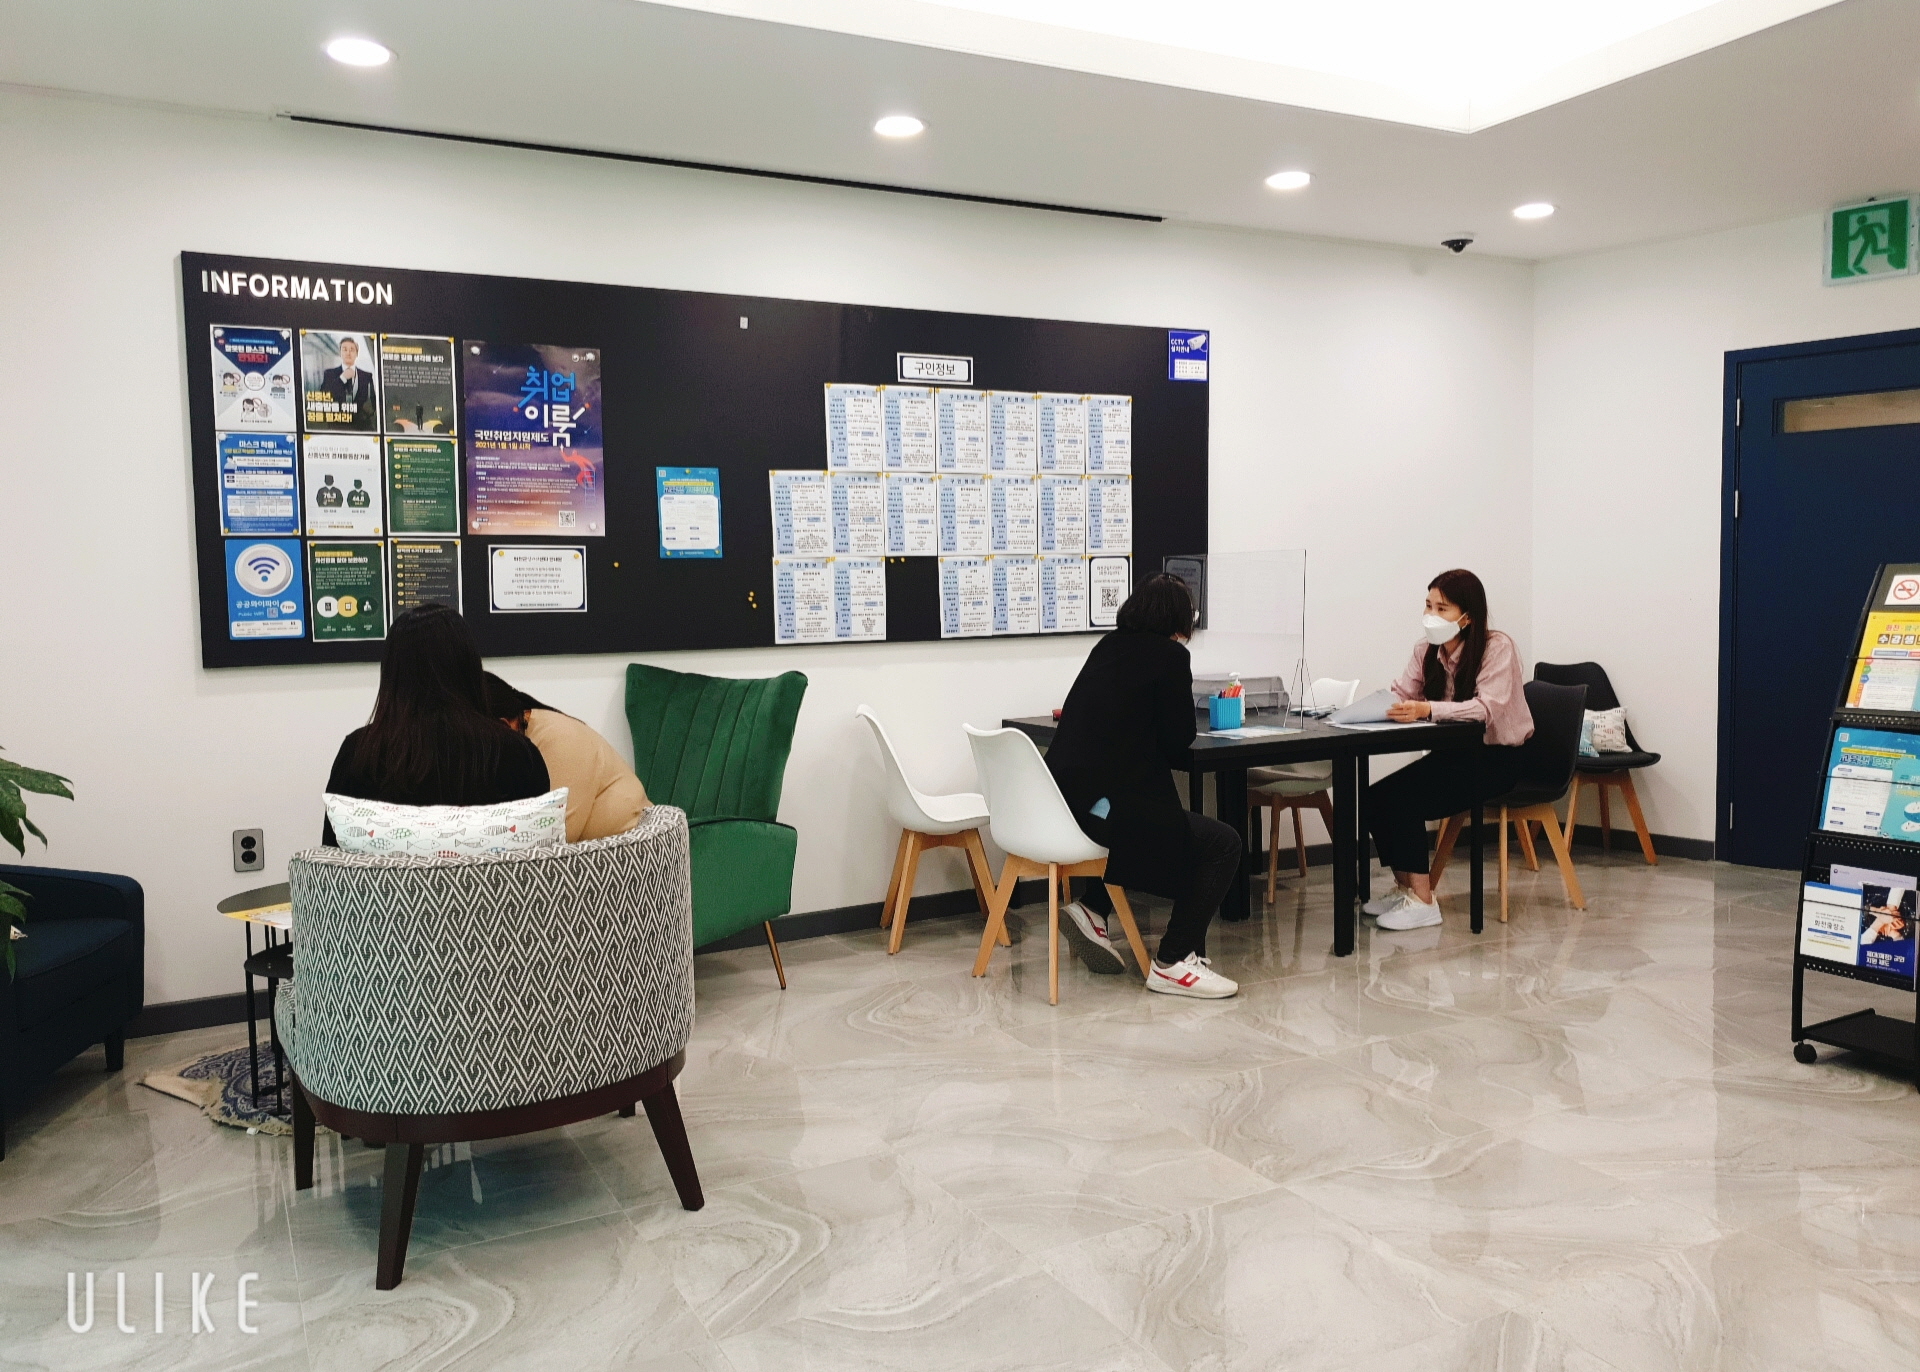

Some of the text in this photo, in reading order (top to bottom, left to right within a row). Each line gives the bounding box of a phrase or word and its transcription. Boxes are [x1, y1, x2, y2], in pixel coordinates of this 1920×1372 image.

[201, 269, 393, 306] INFORMATION
[1170, 338, 1185, 346] CCTV
[245, 345, 265, 354] 마스크
[914, 361, 956, 377] 구인정보
[517, 365, 577, 409] 취업
[341, 402, 358, 414] 위해
[307, 412, 324, 422] 꿈을
[474, 429, 550, 443] 국민취업지원제도
[239, 440, 260, 449] 마스크
[475, 441, 531, 450] 2021년 1월 1일 시작
[236, 599, 280, 609] 공공와이파이
[1814, 919, 1845, 931] 화천출장소
